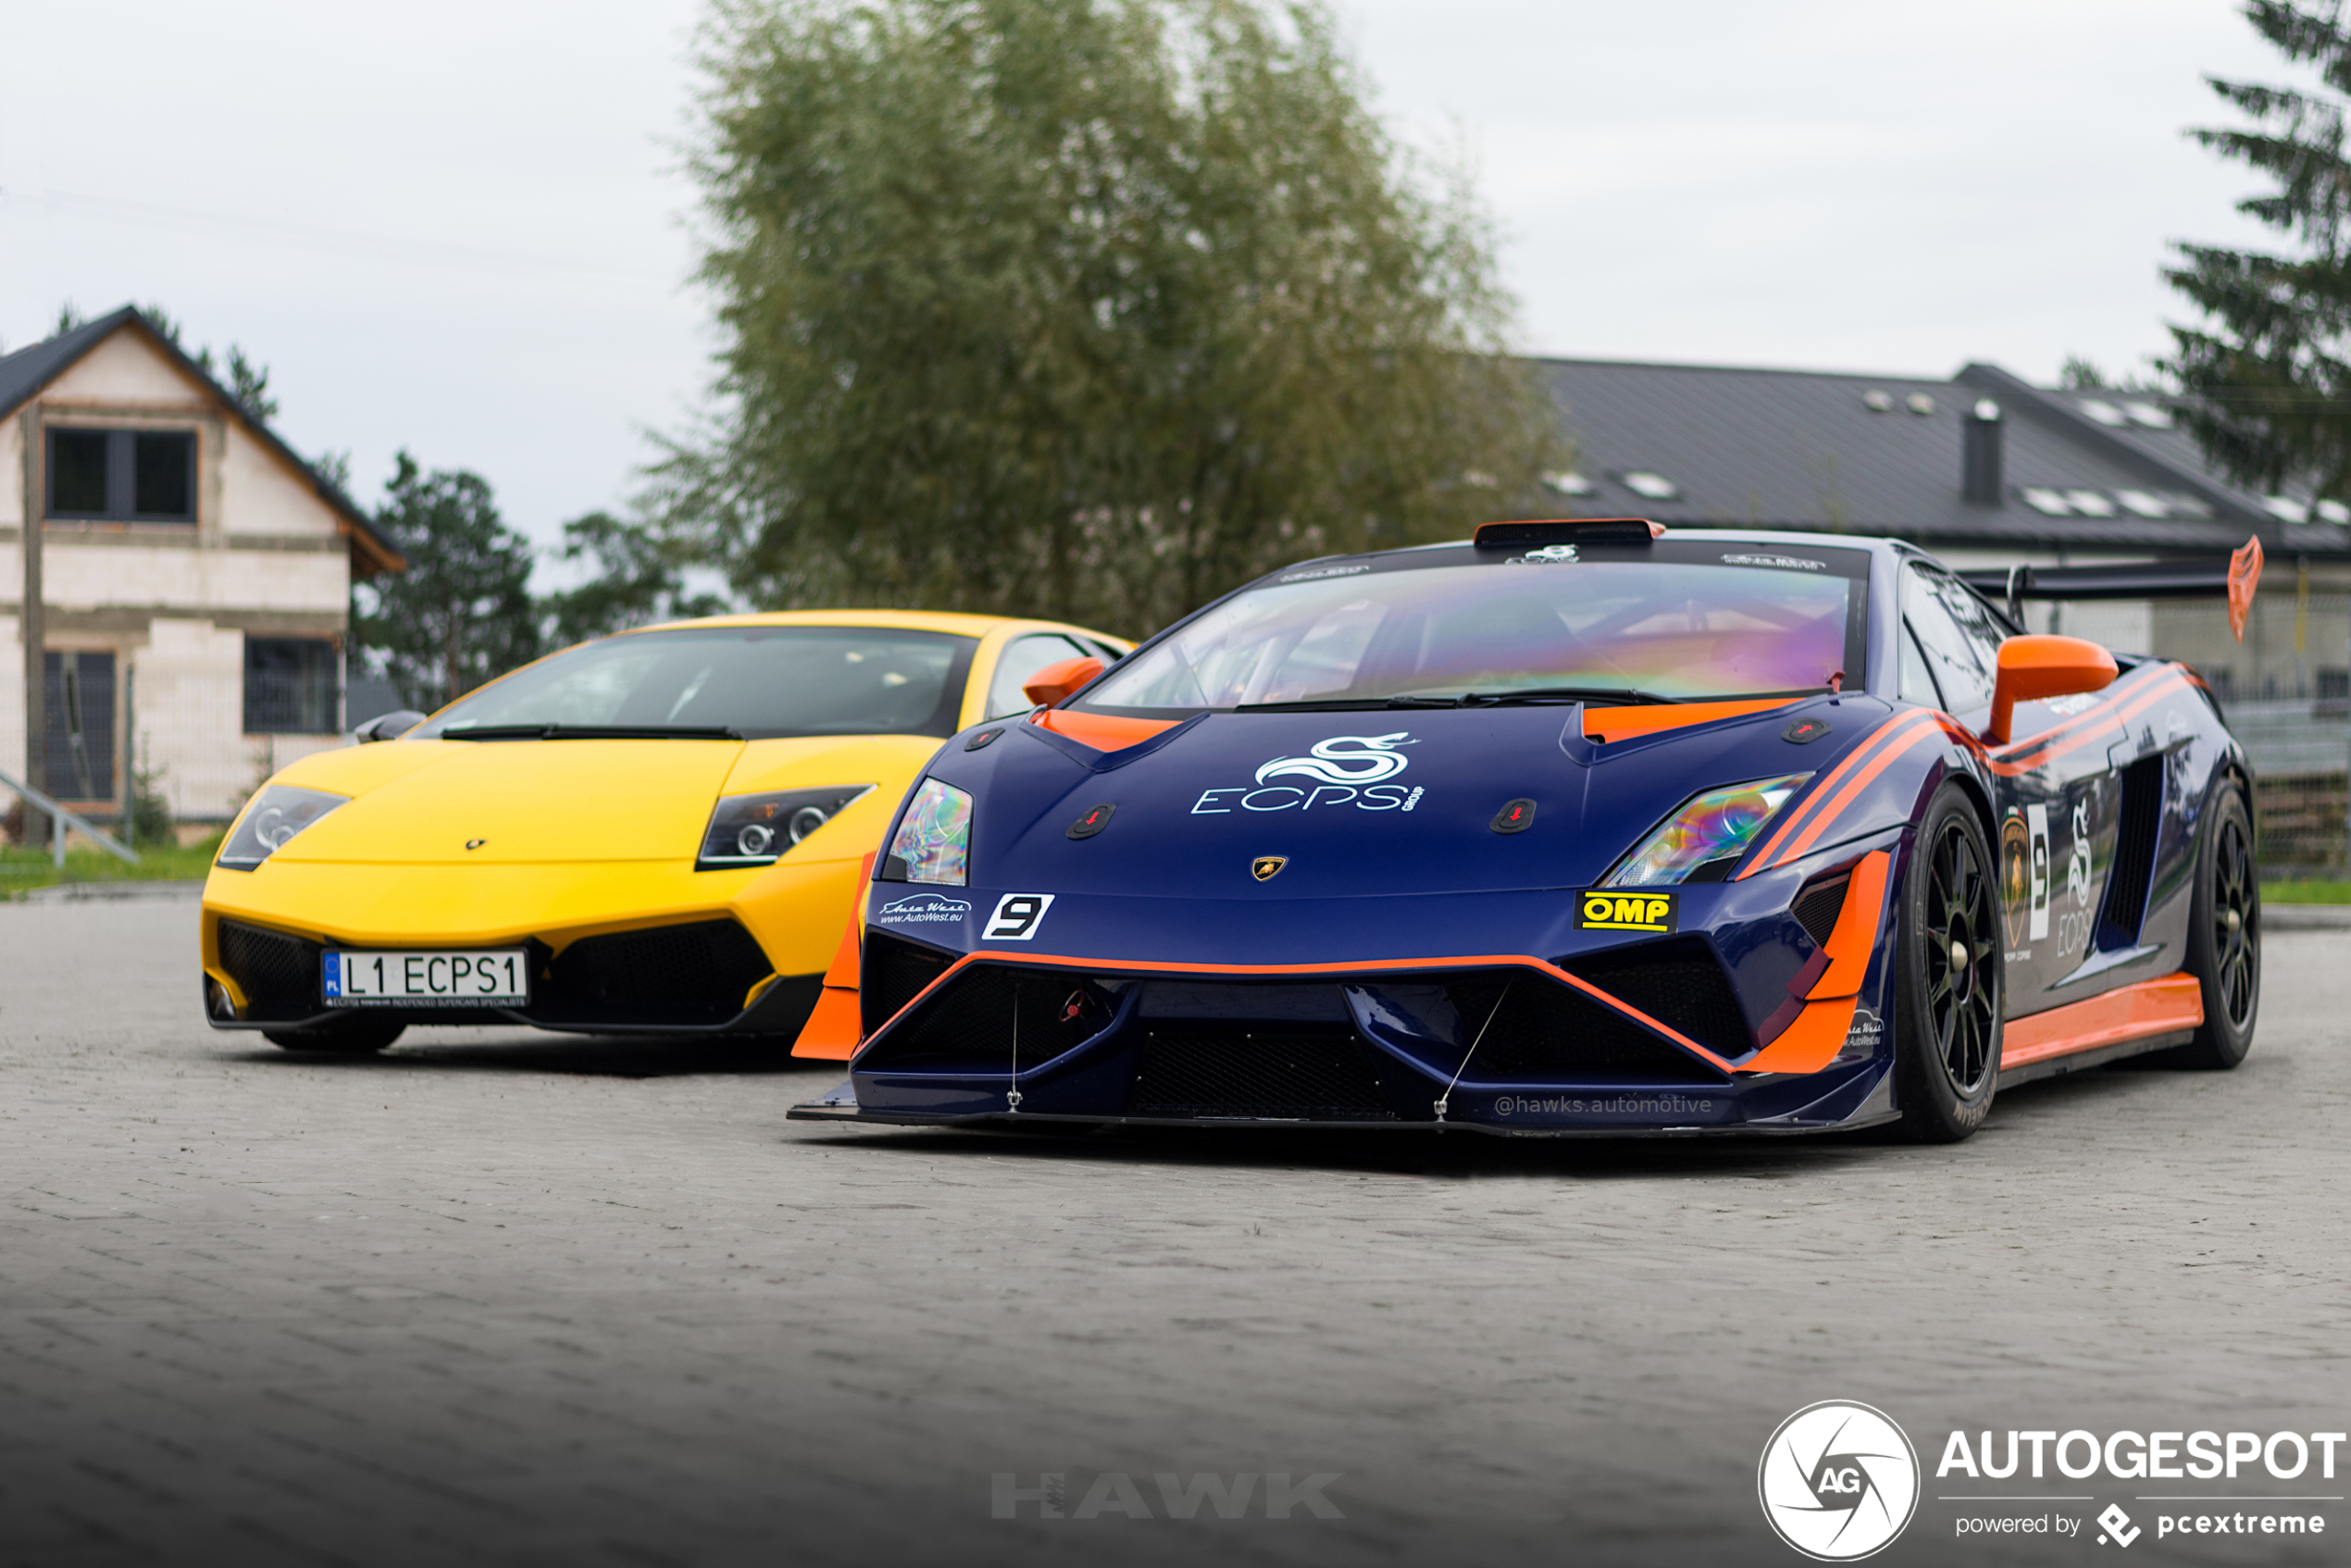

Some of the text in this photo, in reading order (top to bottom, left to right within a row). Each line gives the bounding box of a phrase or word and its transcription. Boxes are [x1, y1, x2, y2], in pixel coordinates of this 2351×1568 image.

[1190, 785, 1410, 815] ECPS
[1400, 786, 1425, 812] GROUP
[881, 912, 964, 924] www.AutoWest.eu
[885, 902, 965, 913] Auto West
[990, 896, 1043, 937] 9
[1584, 898, 1669, 924] OMP
[327, 979, 339, 992] PL
[347, 956, 516, 993] L1 ECPS1
[1862, 1022, 1882, 1033] West
